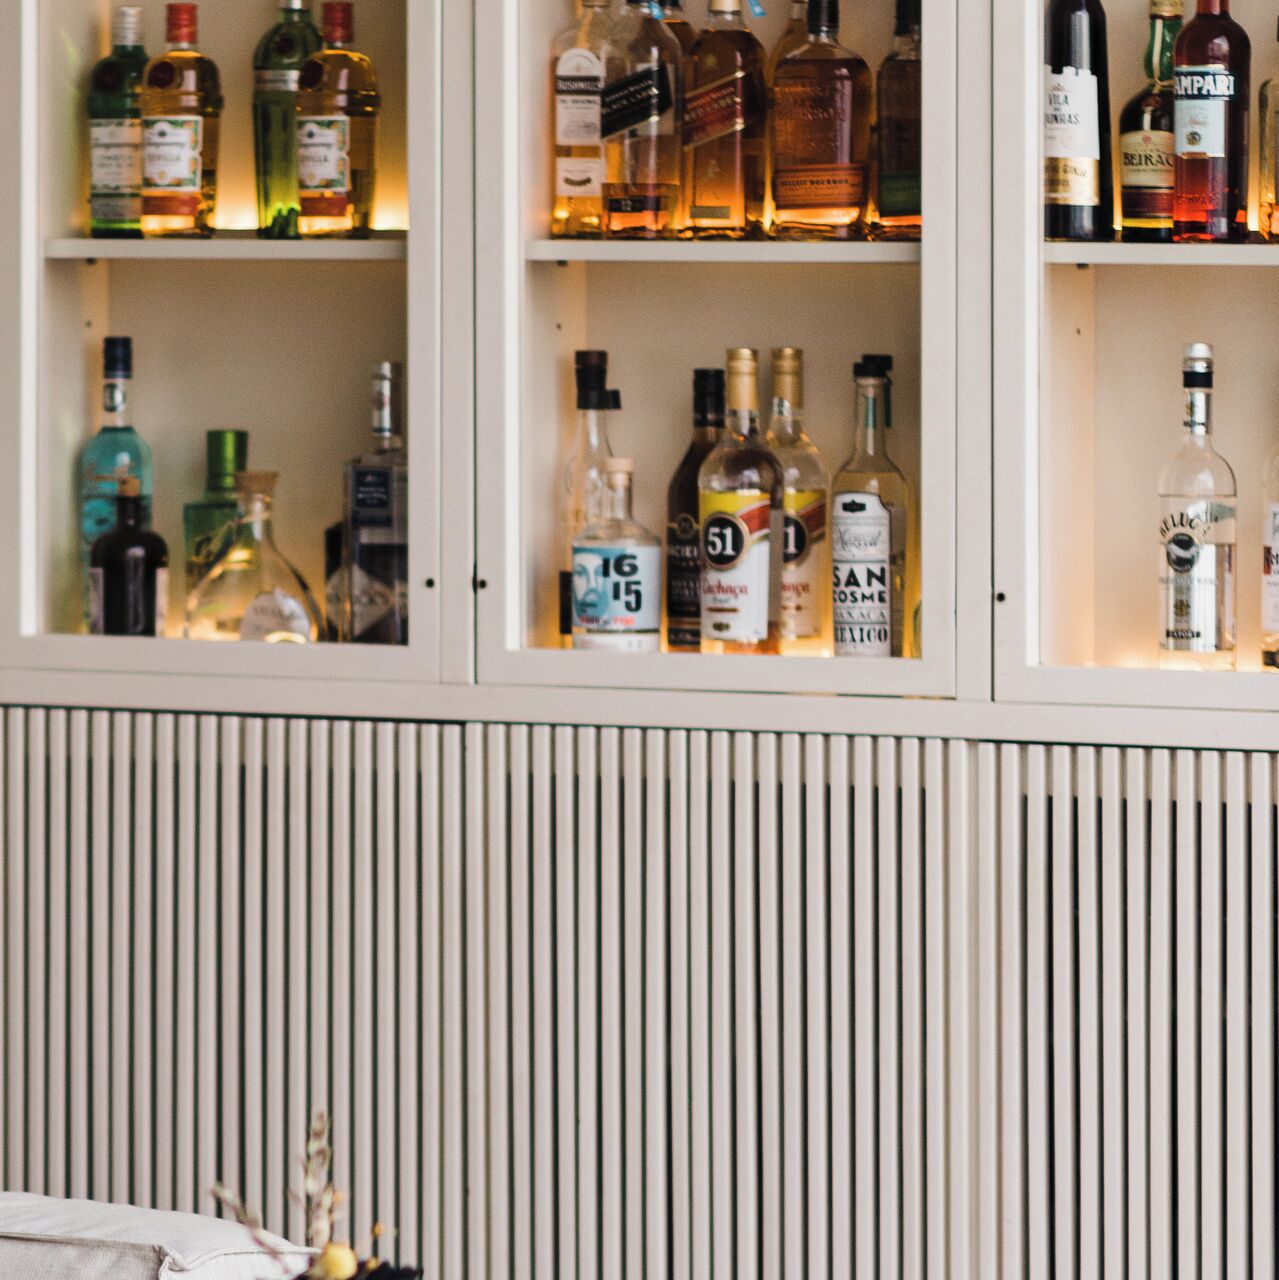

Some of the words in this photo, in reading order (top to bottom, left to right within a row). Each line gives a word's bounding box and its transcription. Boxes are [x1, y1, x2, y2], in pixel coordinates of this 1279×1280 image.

[1175, 75, 1234, 96] AMPARI
[707, 527, 737, 556] 51
[784, 524, 798, 554] 1
[602, 553, 639, 578] 16
[833, 566, 886, 588] SAN
[612, 580, 642, 613] 15
